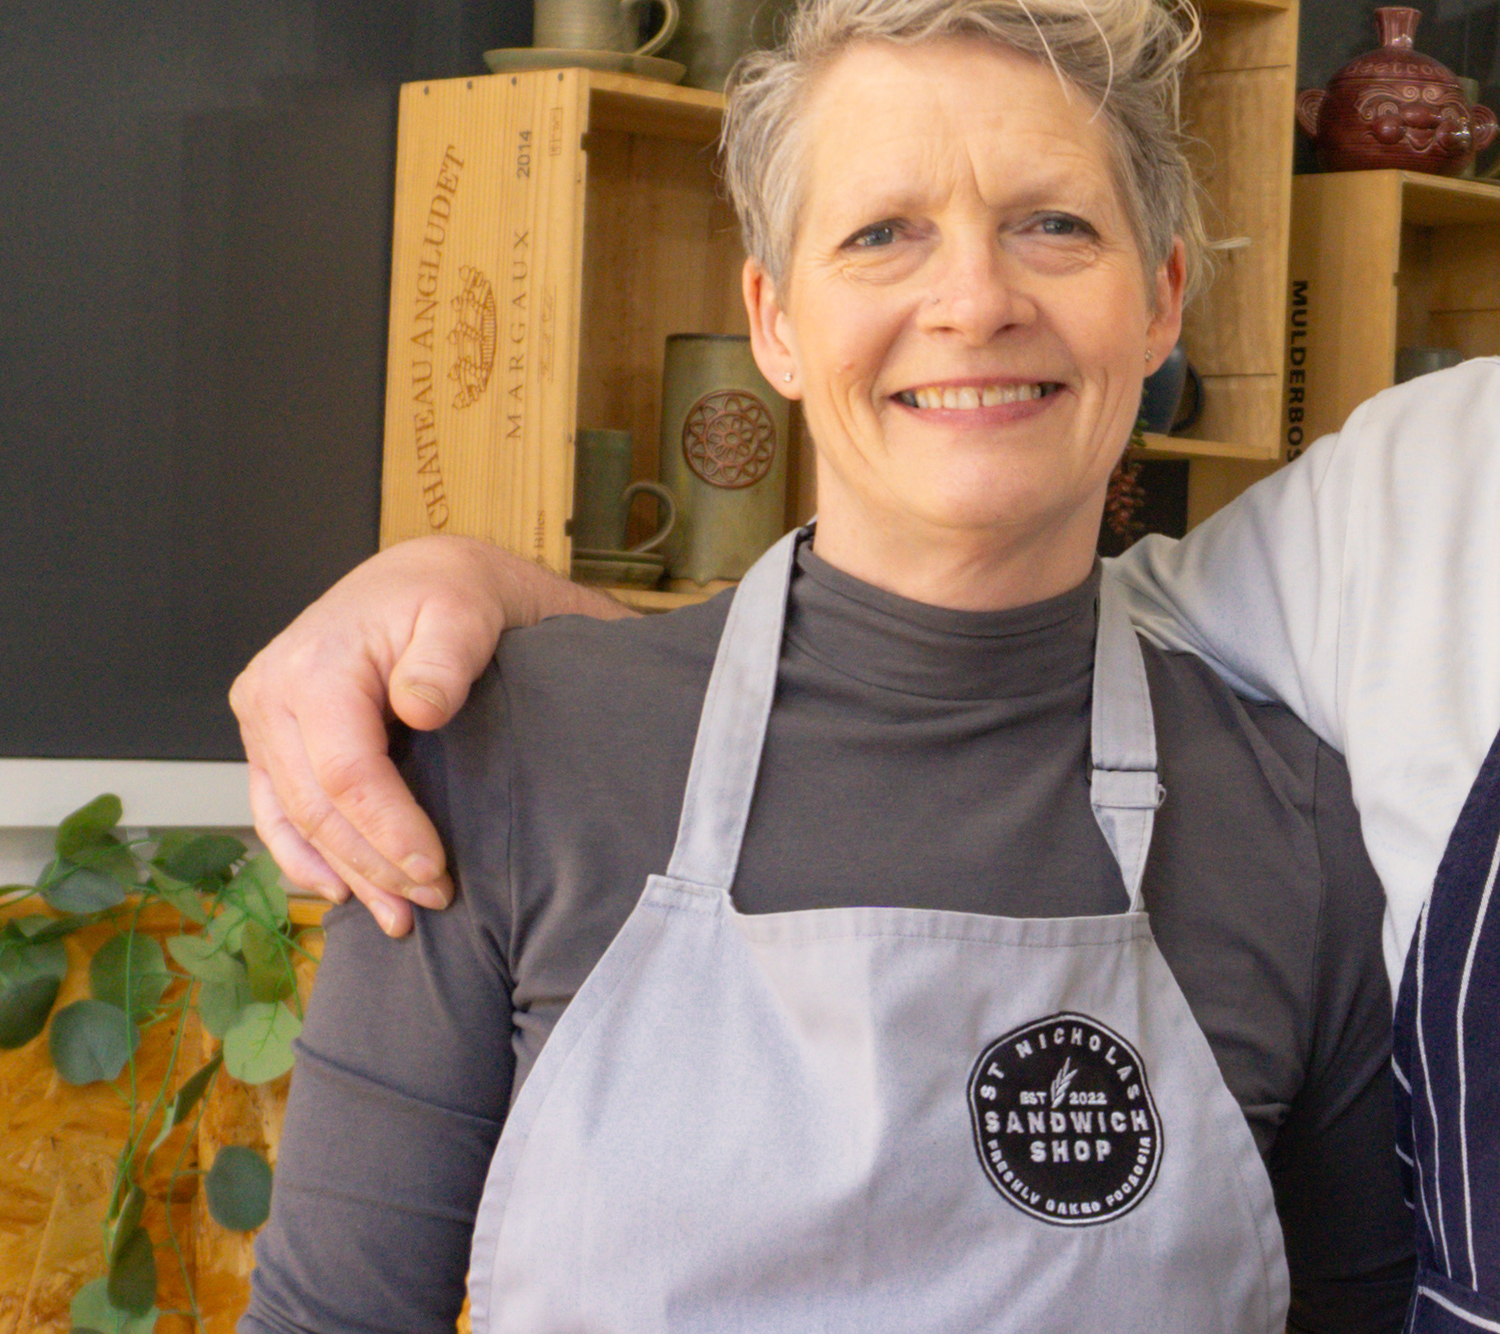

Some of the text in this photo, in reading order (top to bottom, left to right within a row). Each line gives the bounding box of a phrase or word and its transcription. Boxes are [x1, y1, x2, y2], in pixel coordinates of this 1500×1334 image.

[516, 129, 532, 179] 2014
[410, 144, 466, 532] CHATEAU ANGLUDET
[505, 229, 531, 440] MARGAUX
[980, 1027, 1140, 1100] ST NICHOLAS
[985, 1109, 1150, 1133] SANDWICH
[1020, 1091, 1108, 1105] EST 2022
[988, 1137, 1151, 1215] FRESHLY BAKED FOCACCIA
[1030, 1139, 1111, 1163] SHOP
